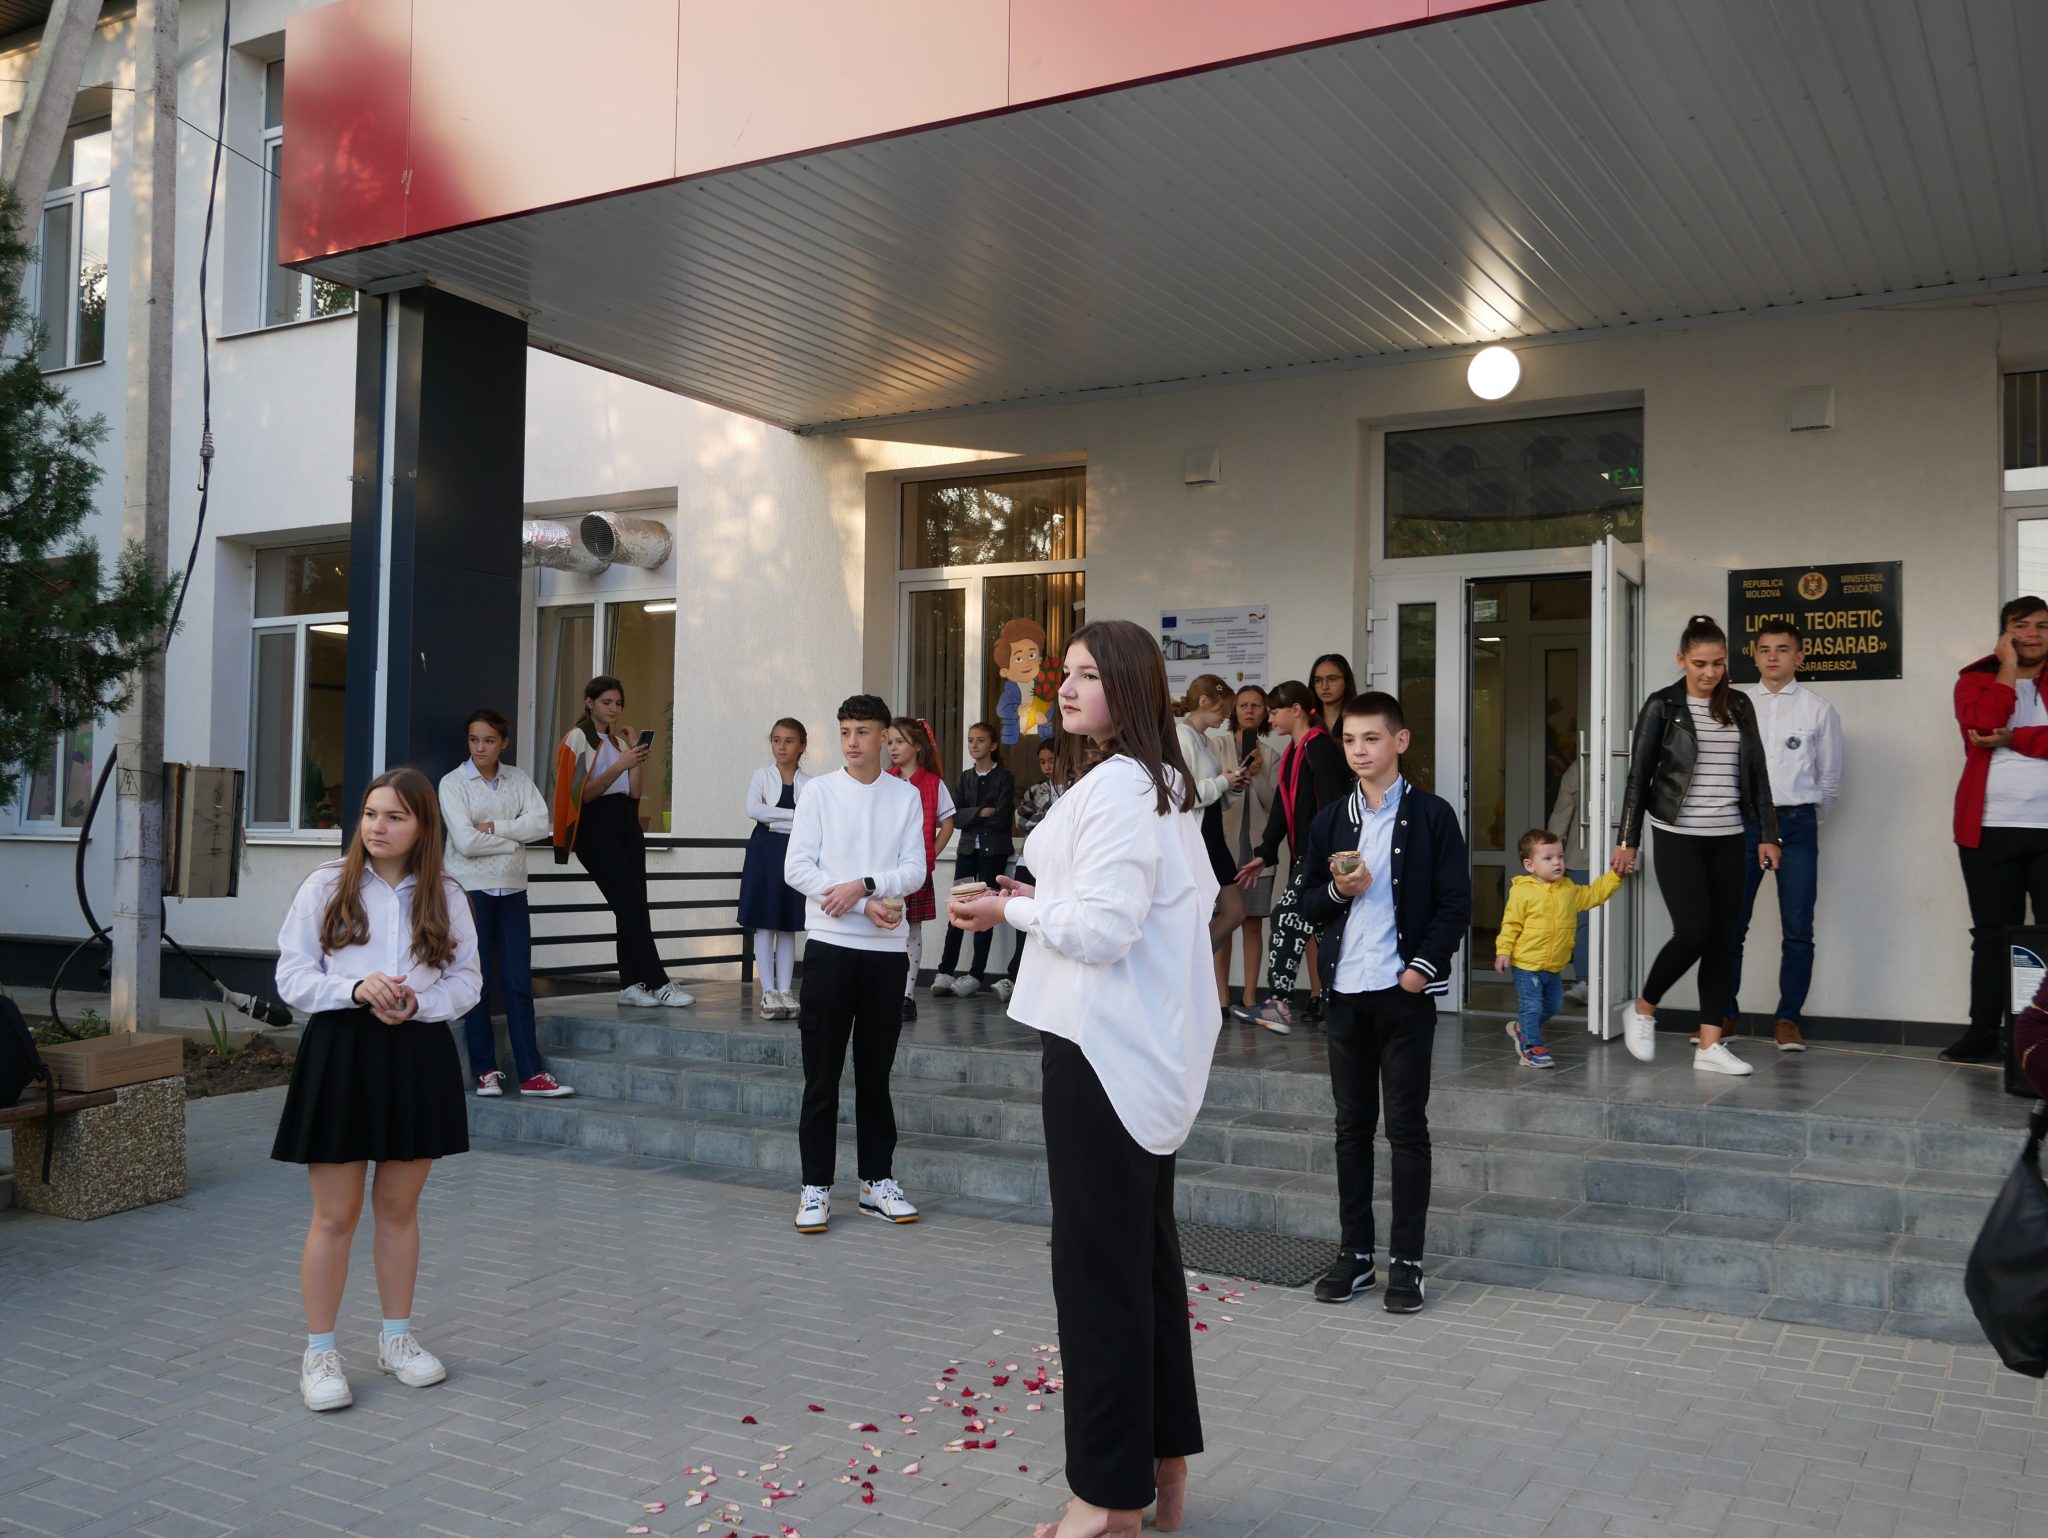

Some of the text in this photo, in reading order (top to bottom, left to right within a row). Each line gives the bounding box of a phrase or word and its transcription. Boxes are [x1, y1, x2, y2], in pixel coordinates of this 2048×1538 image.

[1743, 578, 1783, 588] REPUBLICA
[1841, 573, 1885, 583] MINISTERUL
[1745, 589, 1781, 598] MOLDOVA
[1804, 609, 1883, 630] TEORETIC
[1795, 660, 1857, 672] SARABEASCA
